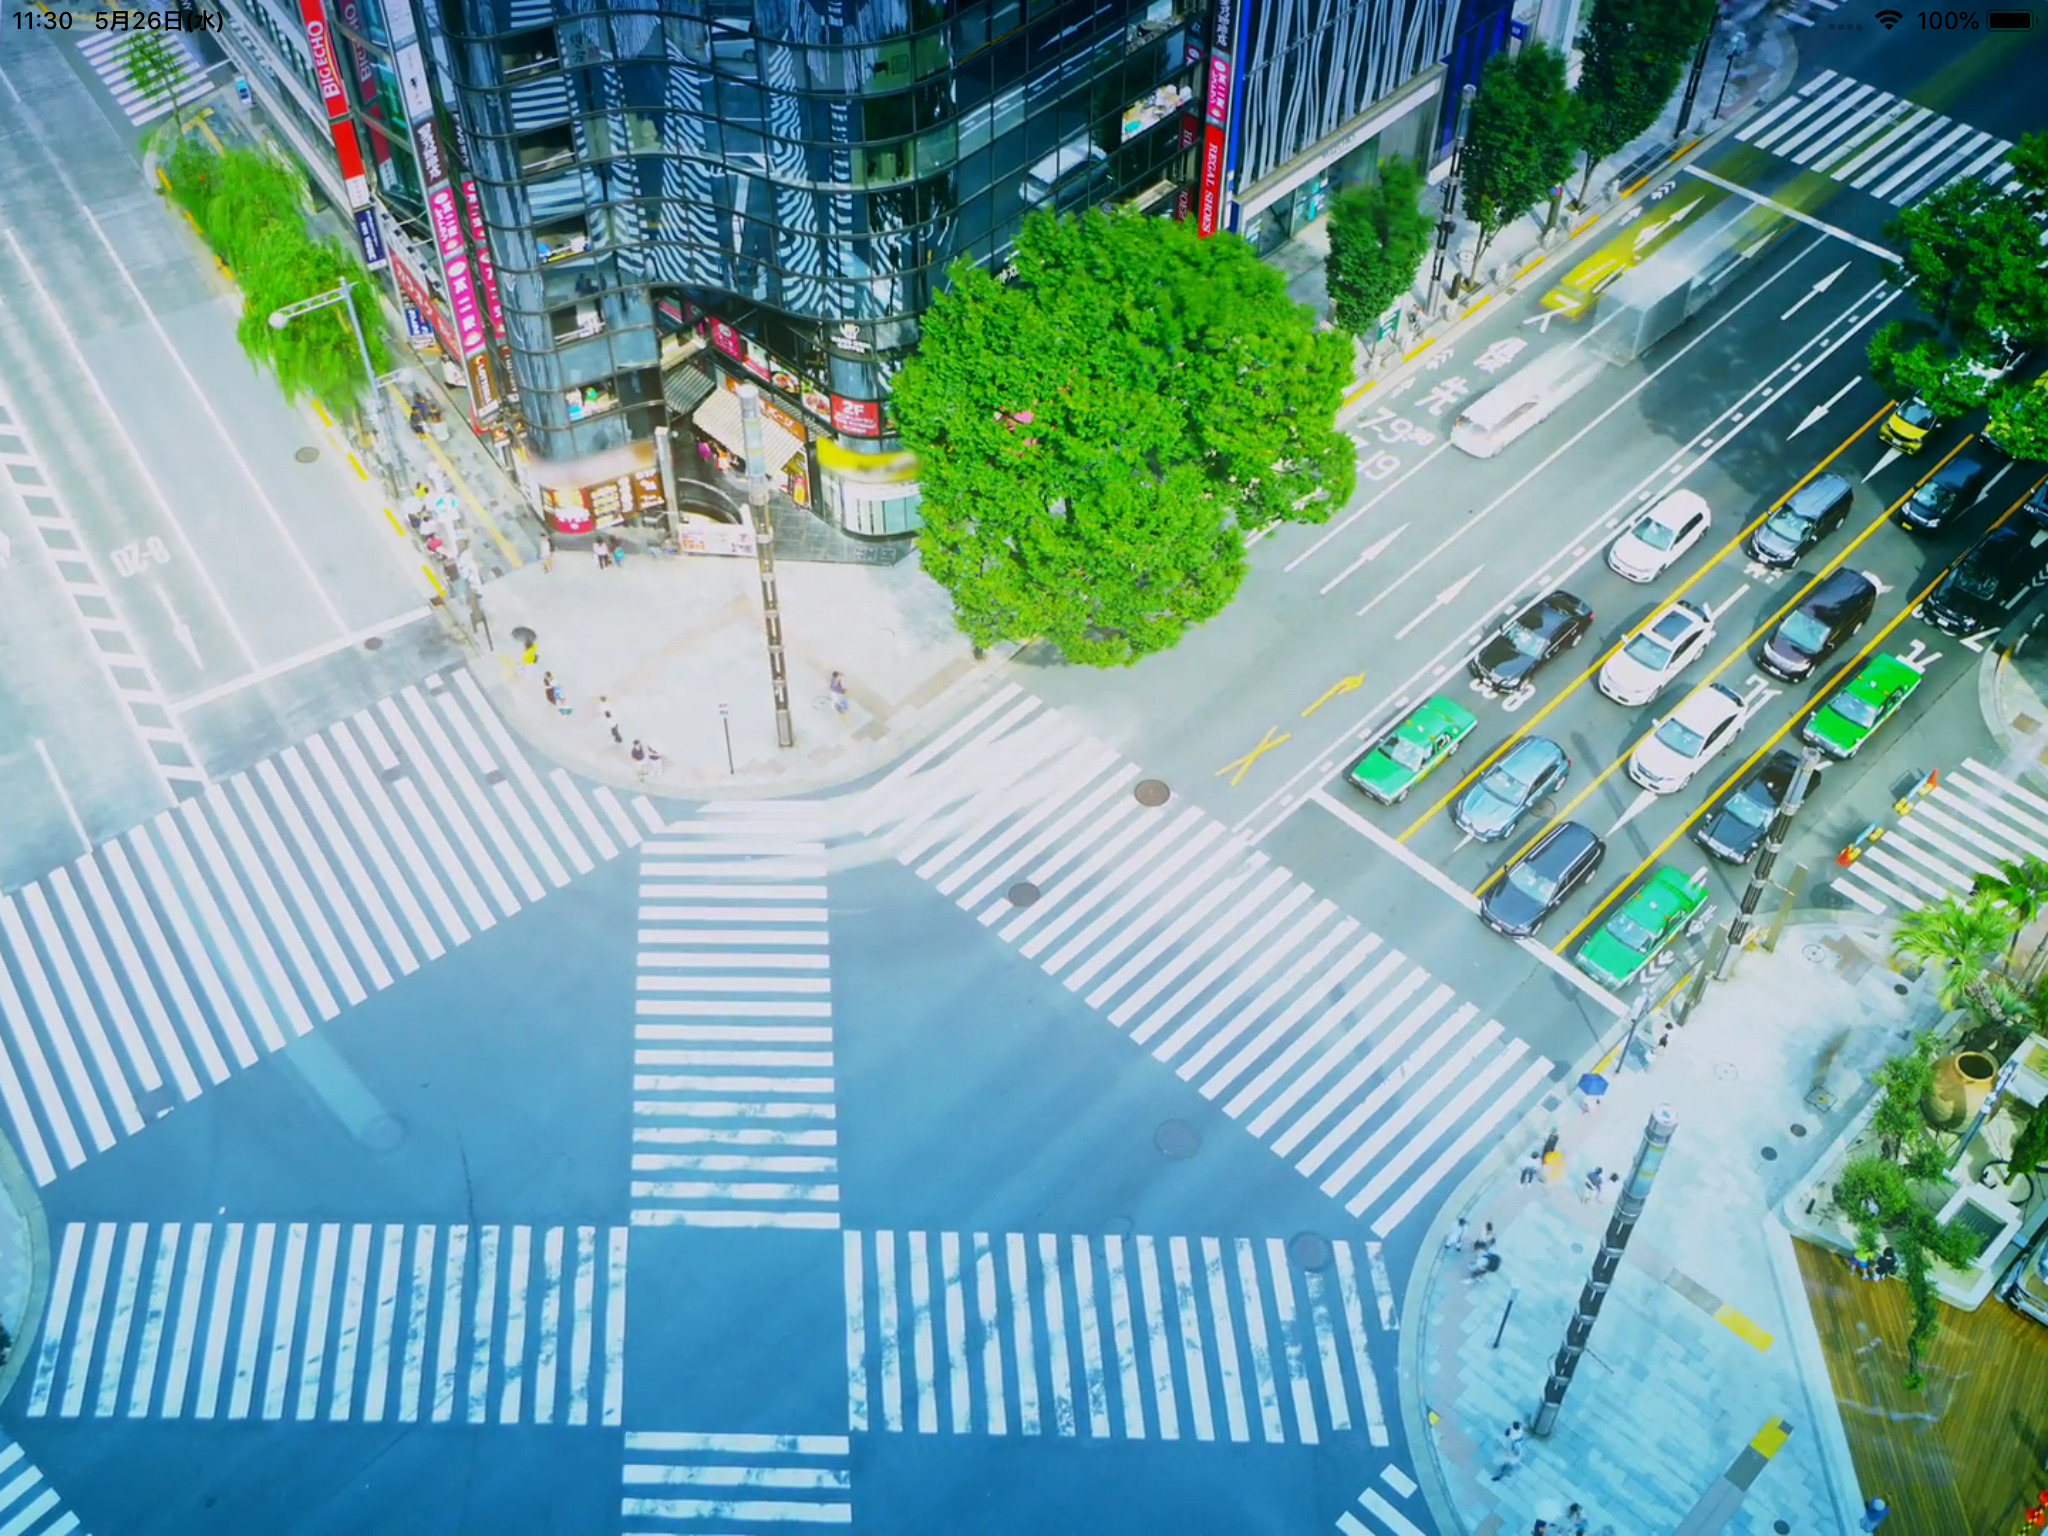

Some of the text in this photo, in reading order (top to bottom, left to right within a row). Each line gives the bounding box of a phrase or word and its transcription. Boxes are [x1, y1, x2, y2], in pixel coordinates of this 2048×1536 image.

[308, 20, 341, 99] BIG ECHO
[1202, 142, 1218, 234] REGAL SHOES
[842, 399, 865, 416] 2F
